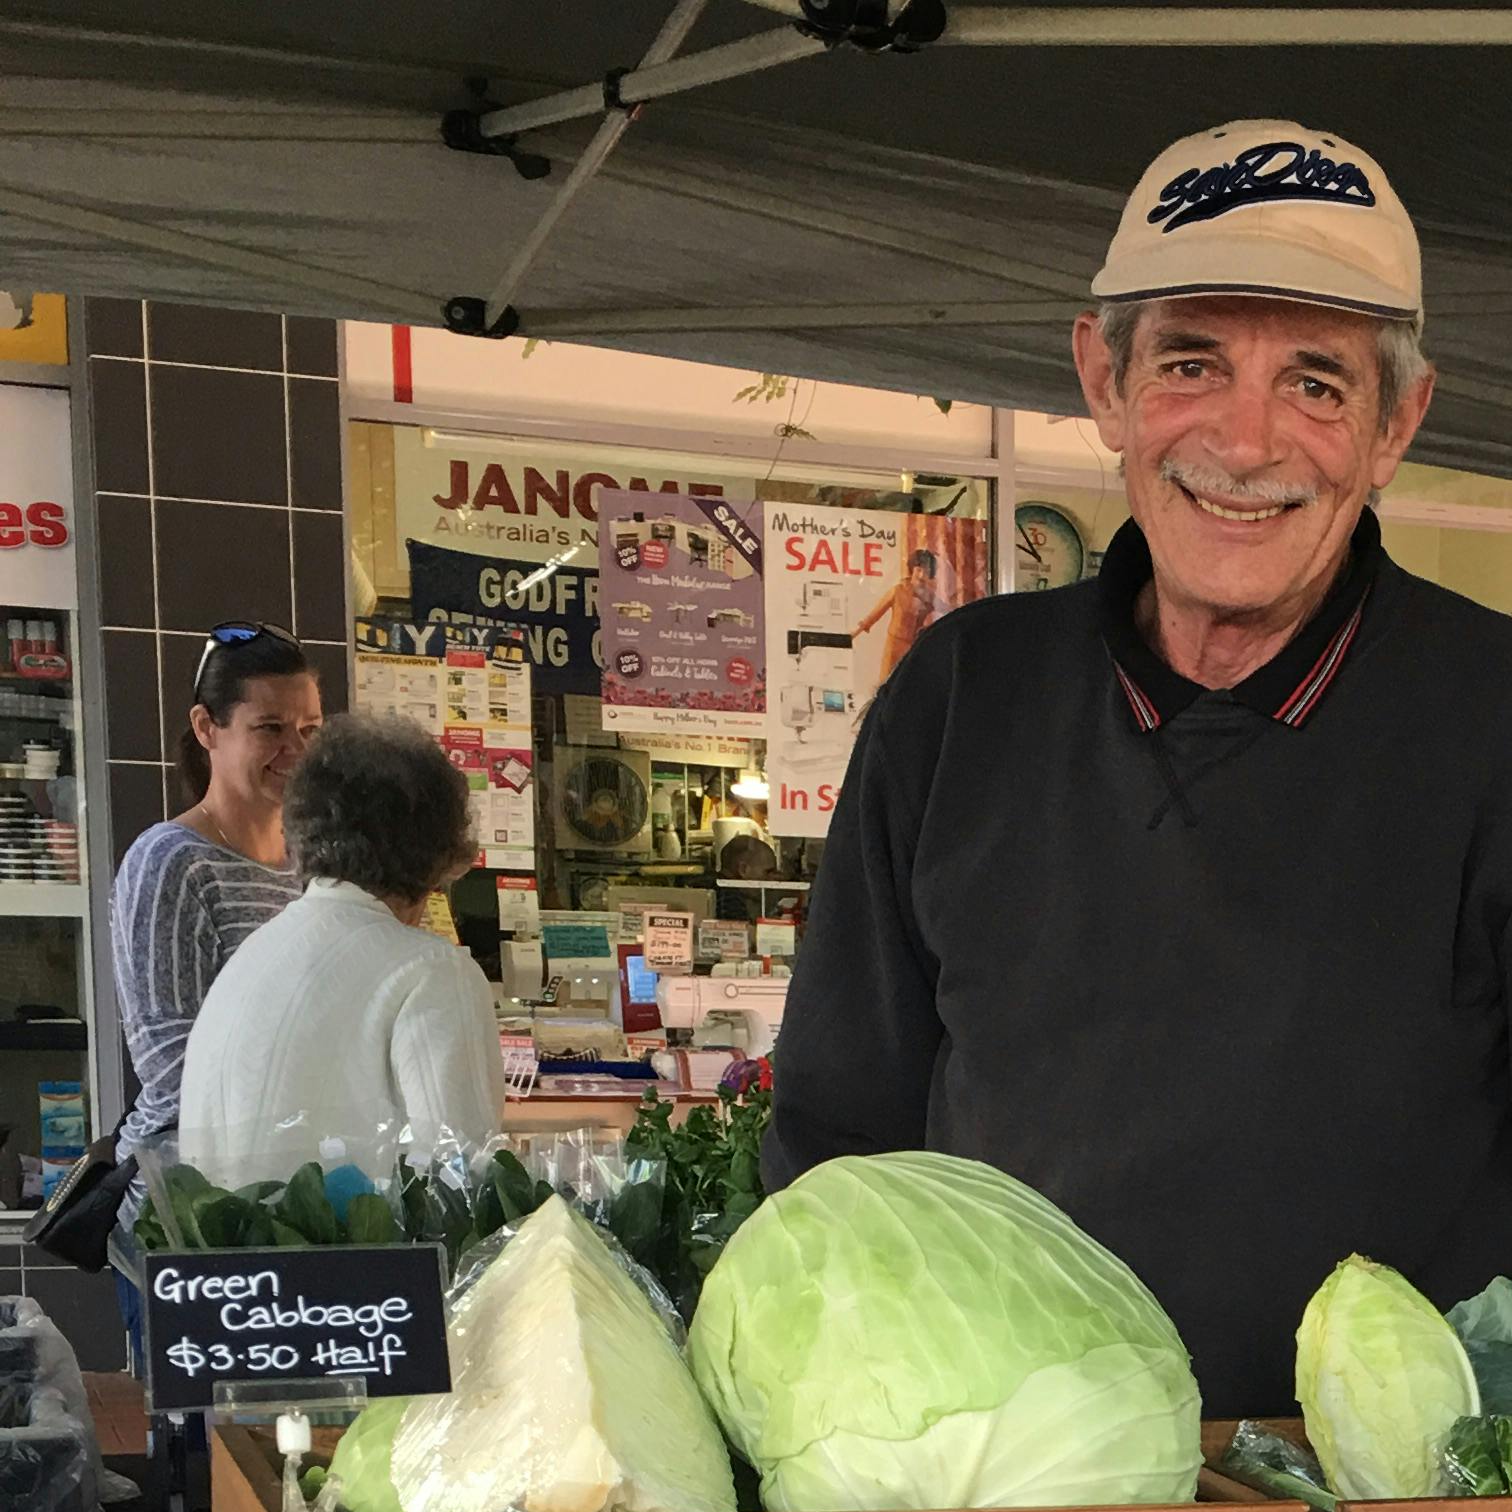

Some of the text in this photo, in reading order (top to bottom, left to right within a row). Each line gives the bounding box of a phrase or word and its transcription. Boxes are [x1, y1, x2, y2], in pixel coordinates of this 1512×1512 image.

[713, 505, 758, 555] SALE
[772, 513, 897, 547] Mother's Day
[619, 547, 637, 558] 10%
[621, 557, 638, 567] OFF
[785, 536, 884, 577] SALE
[620, 655, 639, 665] 10%
[621, 663, 640, 674] OFF
[780, 782, 809, 811] In
[653, 917, 685, 928] SPECIAL
[154, 1266, 280, 1303] Green
[220, 1296, 413, 1339] Cabbage
[166, 1335, 407, 1377] $3.50 Half
